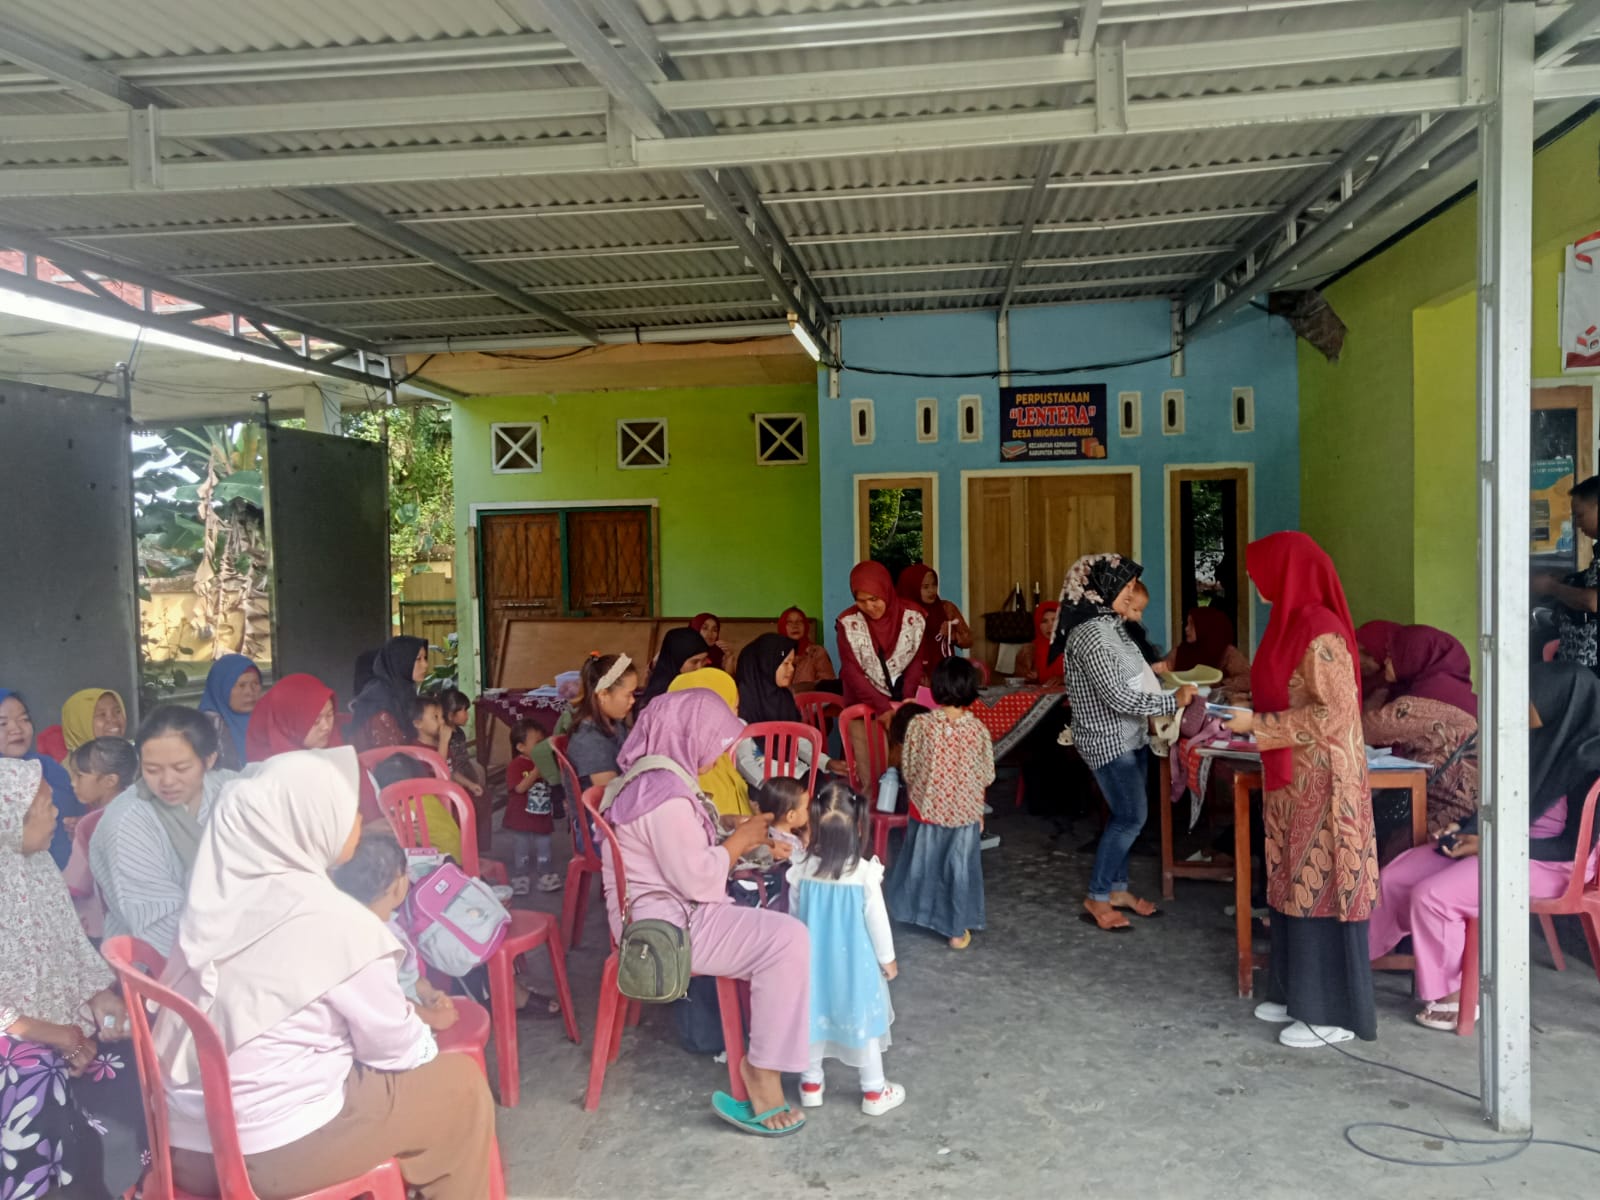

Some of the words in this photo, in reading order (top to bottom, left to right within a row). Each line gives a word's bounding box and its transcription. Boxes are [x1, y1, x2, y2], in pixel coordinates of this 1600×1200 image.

[1016, 392, 1090, 405] PERPUSTAKAAN
[1012, 429, 1031, 438] DESA
[1033, 428, 1066, 438] IMIGRASI
[1068, 427, 1094, 436] PERMU
